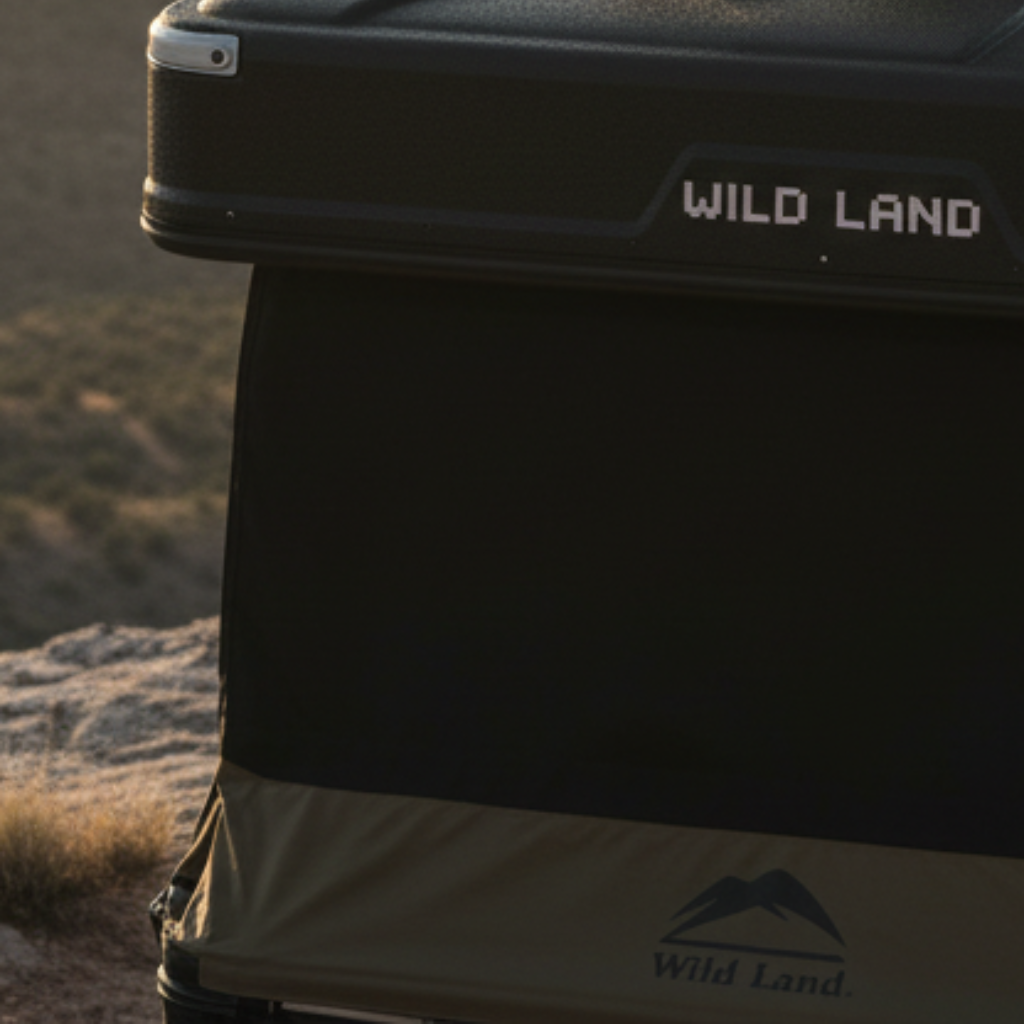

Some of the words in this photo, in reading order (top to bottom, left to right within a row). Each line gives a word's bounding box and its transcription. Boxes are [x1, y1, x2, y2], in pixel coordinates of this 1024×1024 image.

[683, 180, 808, 225] WILD
[835, 190, 981, 238] LAND
[653, 952, 740, 986] Wild
